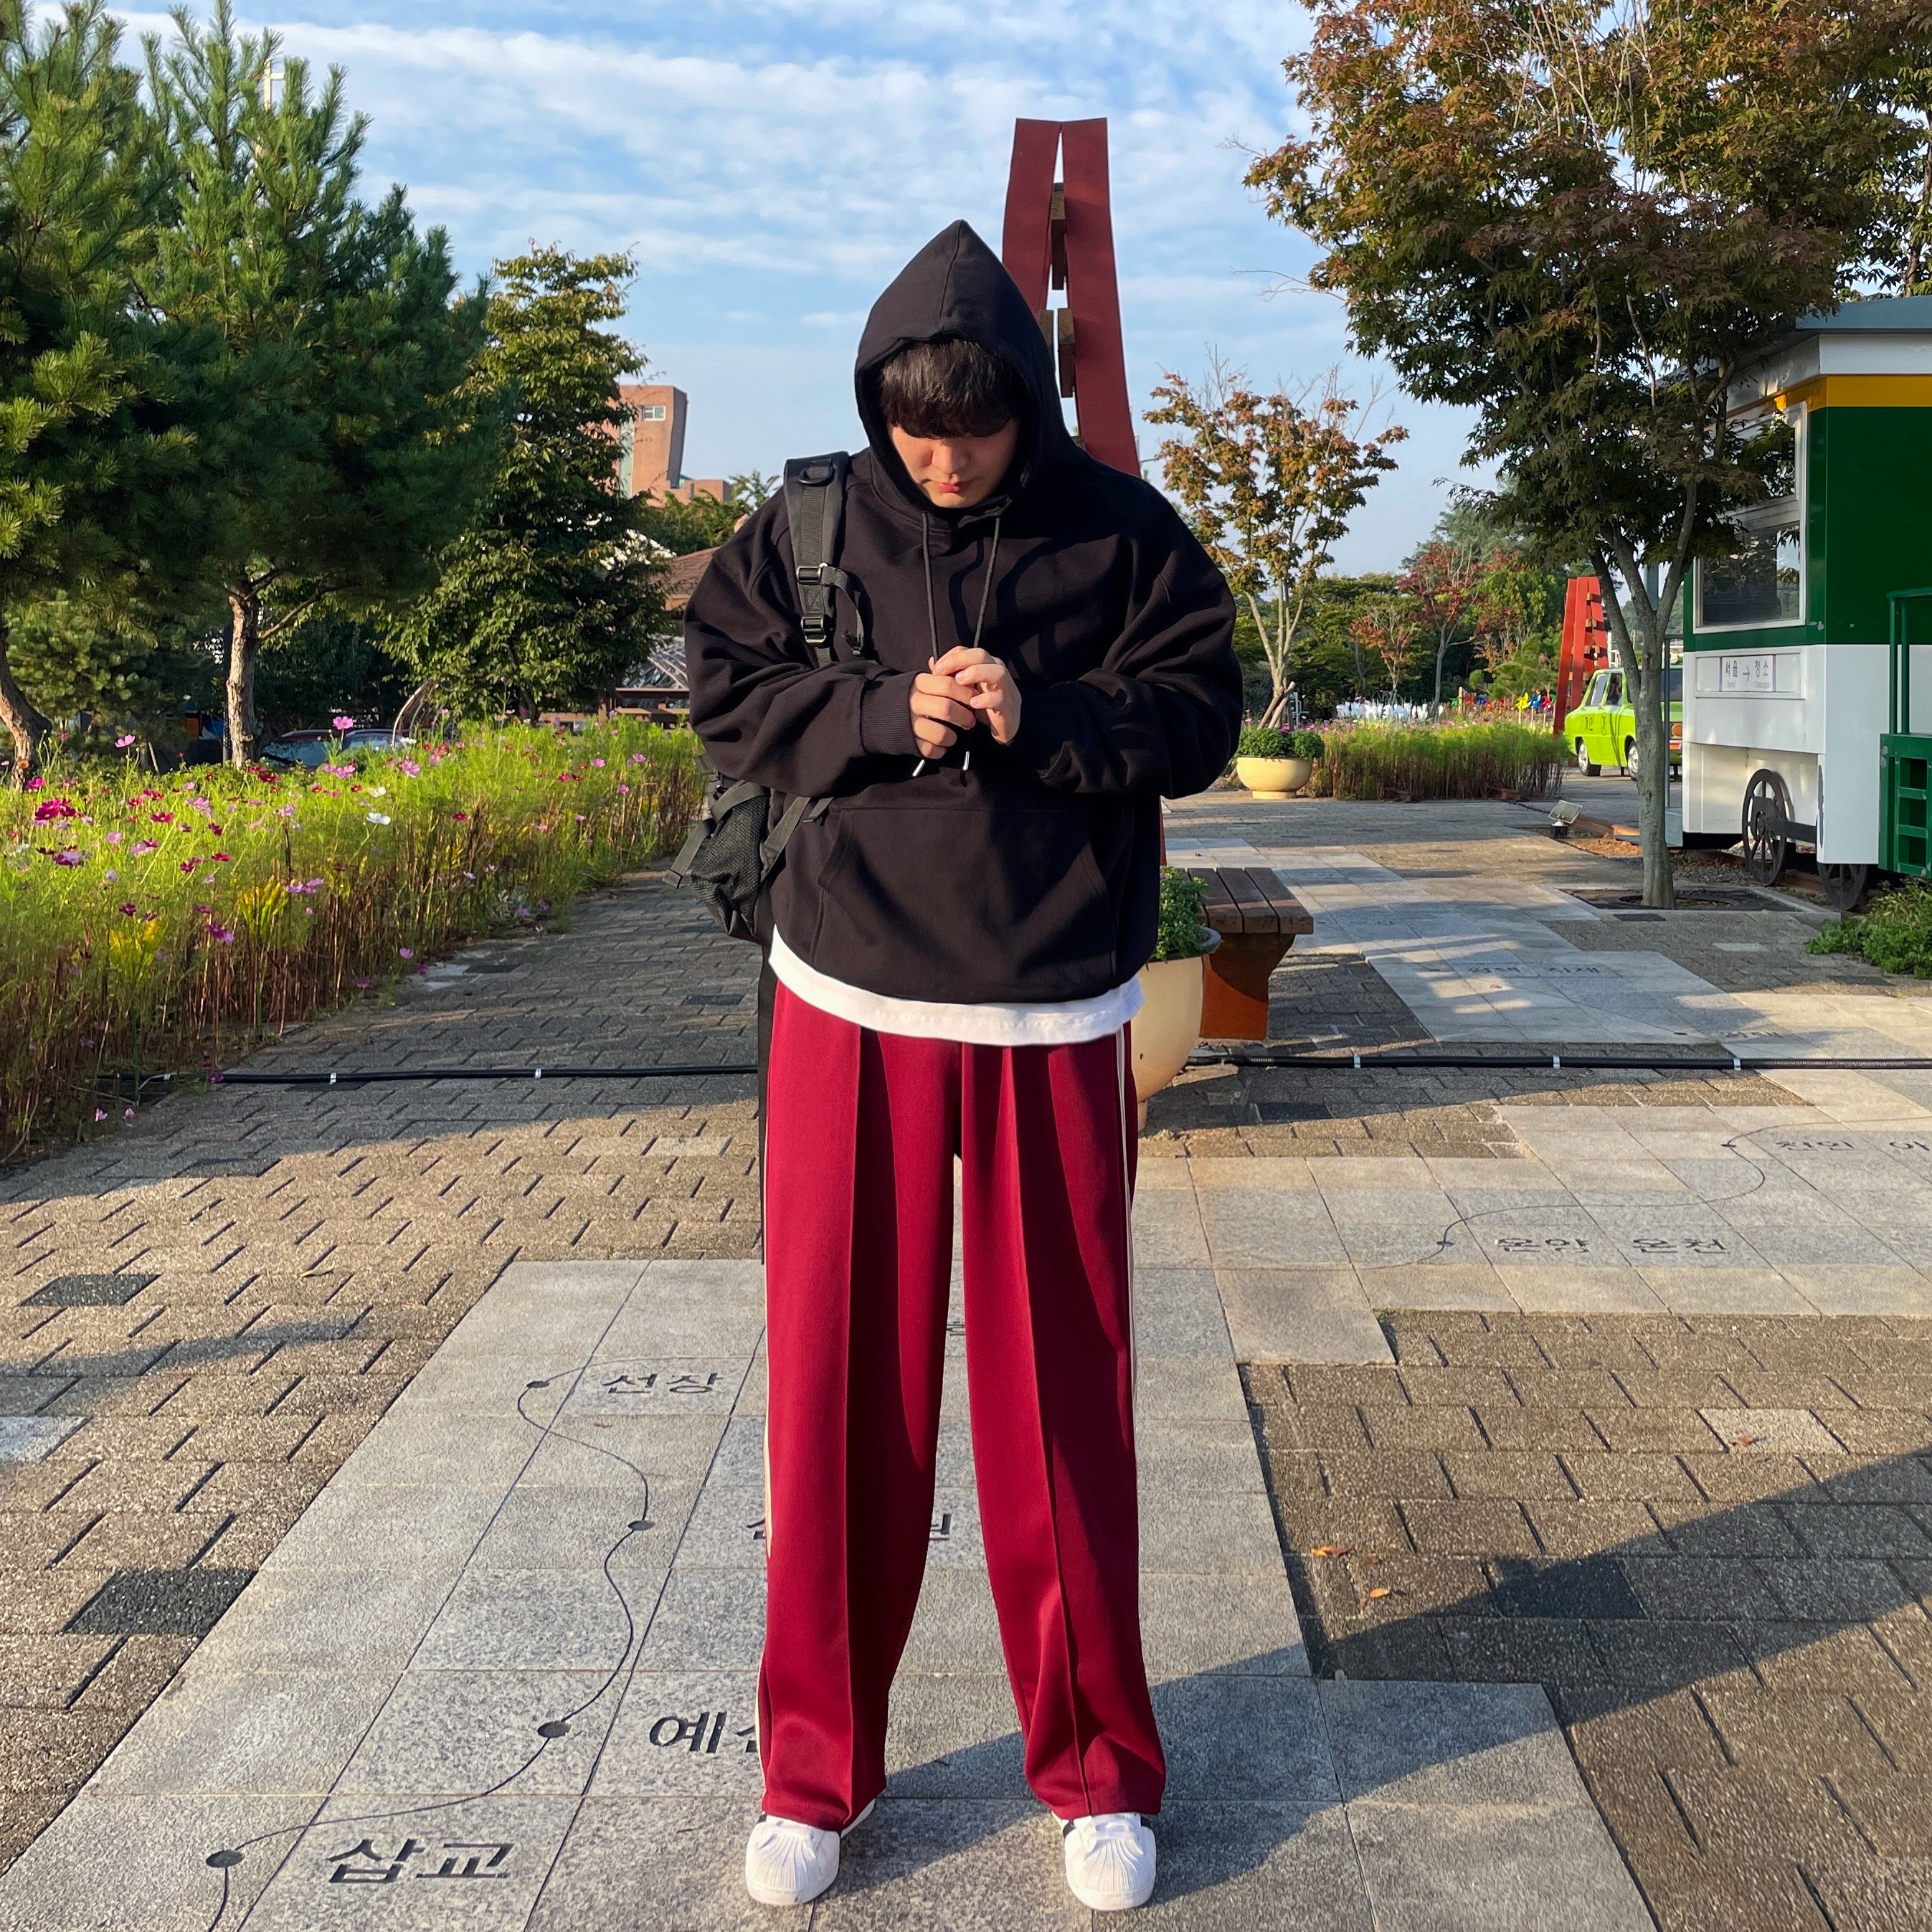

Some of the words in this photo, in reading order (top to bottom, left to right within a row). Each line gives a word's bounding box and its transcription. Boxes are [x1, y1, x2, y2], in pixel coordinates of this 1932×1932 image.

[1725, 660, 1738, 678] 서울
[1754, 660, 1769, 678] 청소
[1497, 1238, 1591, 1254] 온양
[1632, 1238, 1732, 1254] 온천
[602, 1372, 724, 1395] 선장
[326, 1837, 516, 1885] 삽교
